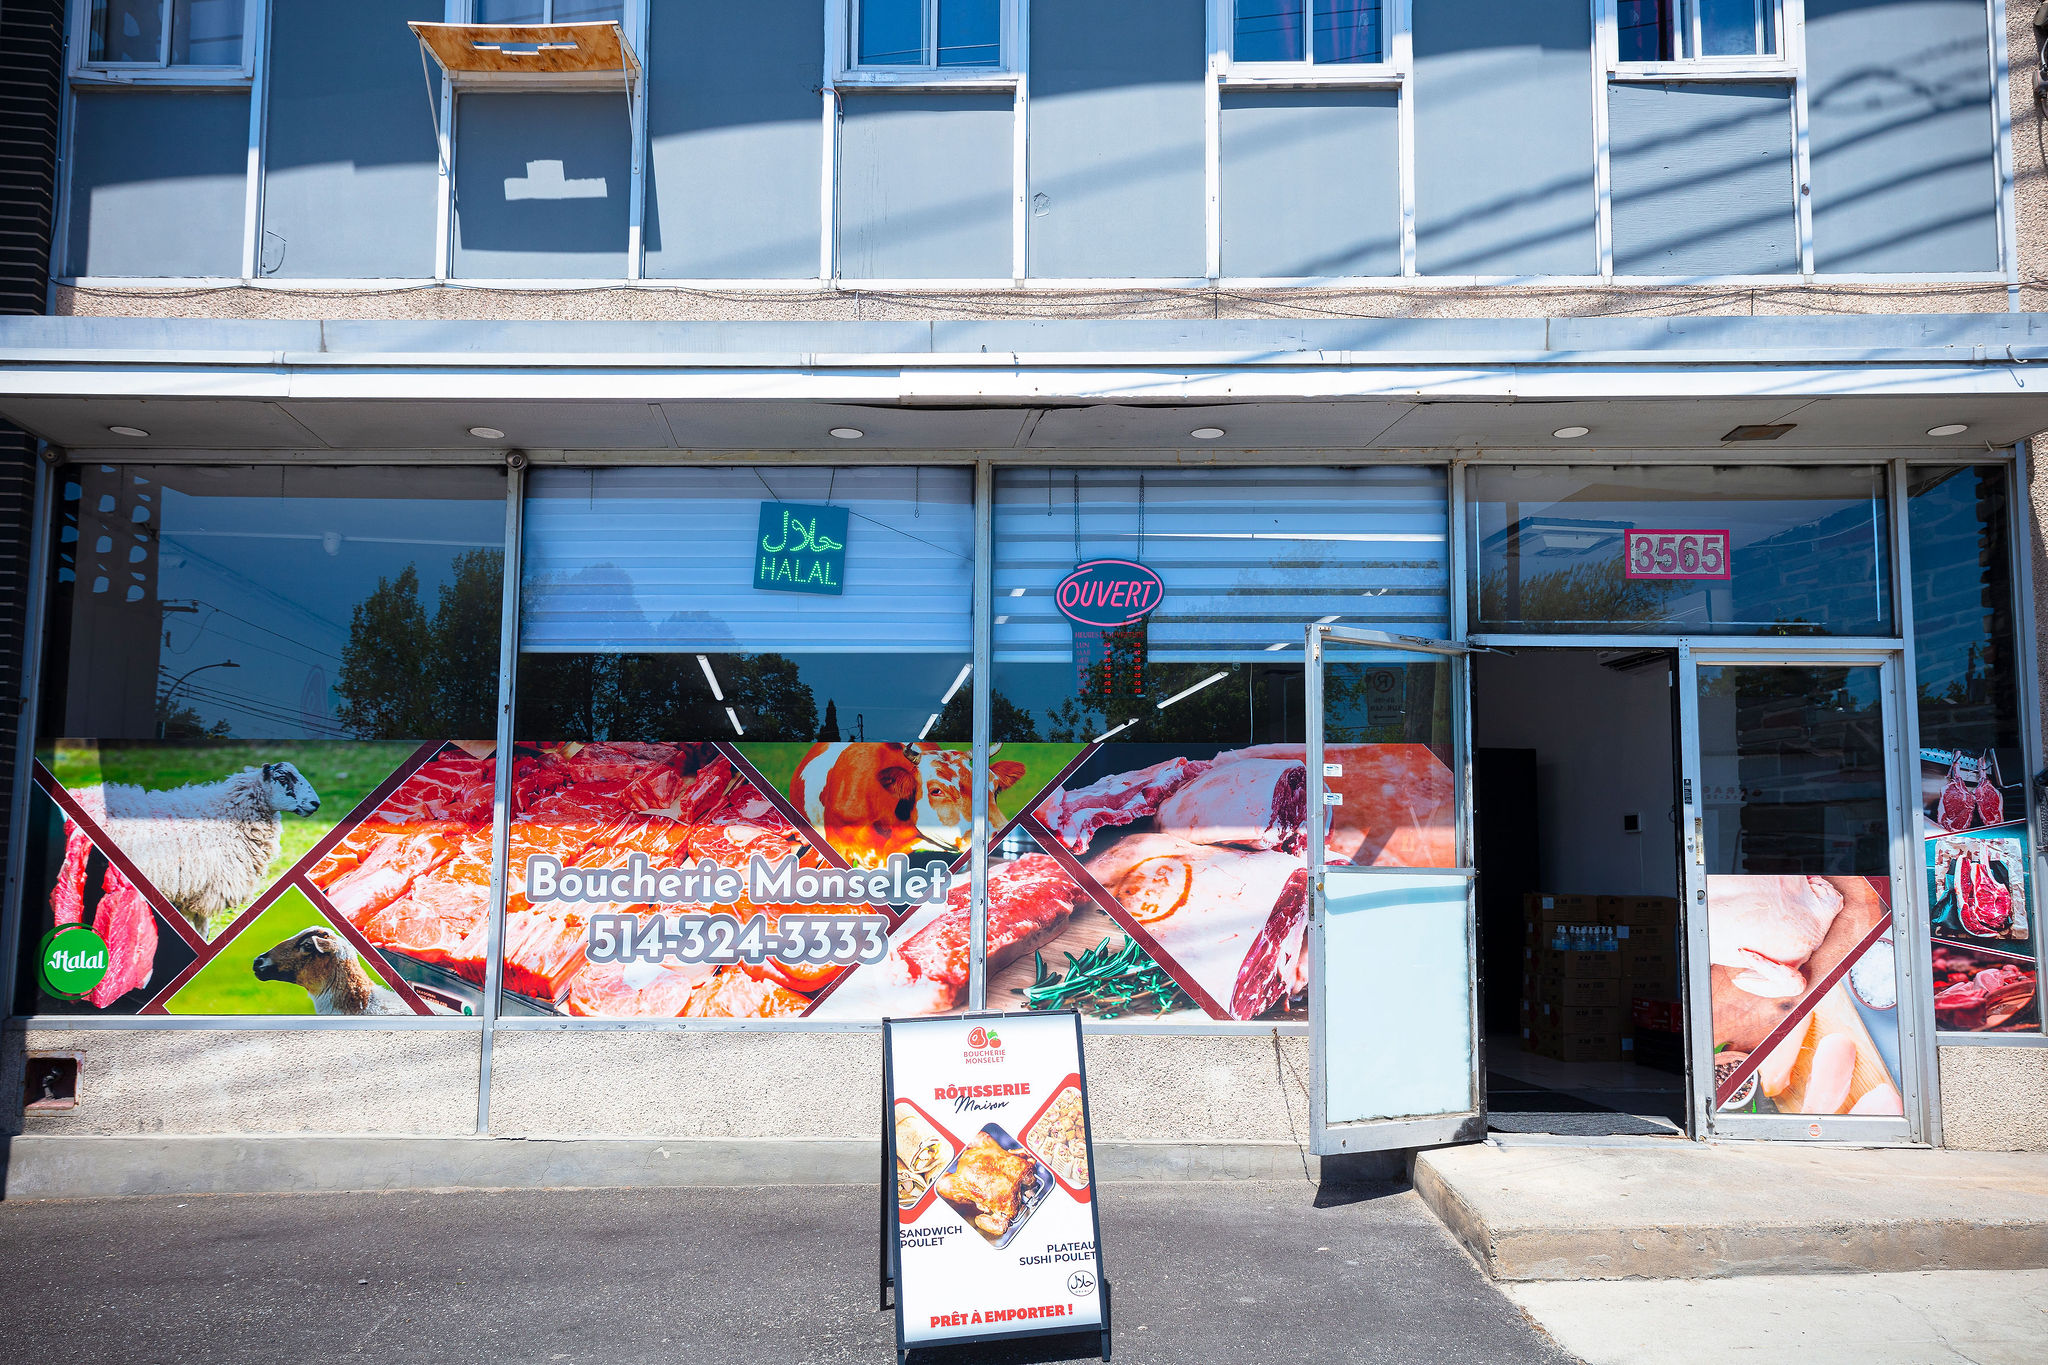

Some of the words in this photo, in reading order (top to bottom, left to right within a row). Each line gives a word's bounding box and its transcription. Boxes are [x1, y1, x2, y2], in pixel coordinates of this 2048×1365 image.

[762, 510, 843, 553] حلال
[1634, 535, 1723, 573] 3565
[760, 556, 837, 586] HALAL
[1062, 580, 1156, 608] OUVERT
[531, 856, 738, 900] Boucherie
[754, 855, 948, 900] Monselet
[590, 917, 886, 961] 514-324-3333
[47, 950, 106, 973] Halal
[963, 1049, 1006, 1058] BOUCHERIE
[965, 1056, 1005, 1064] MONSELET
[934, 1083, 1031, 1100] RÔTISSERIE
[954, 1095, 1010, 1114] Maison
[900, 1225, 963, 1239] SANDWICH
[900, 1236, 945, 1248] POULET
[1047, 1241, 1096, 1253] PLATEAU
[1019, 1254, 1052, 1266] SUSHI
[1054, 1251, 1096, 1263] POULET
[1071, 1275, 1094, 1290] حلال
[930, 1311, 969, 1328] PRÊT
[971, 1310, 983, 1325] À
[985, 1304, 1066, 1323] EMPORTER
